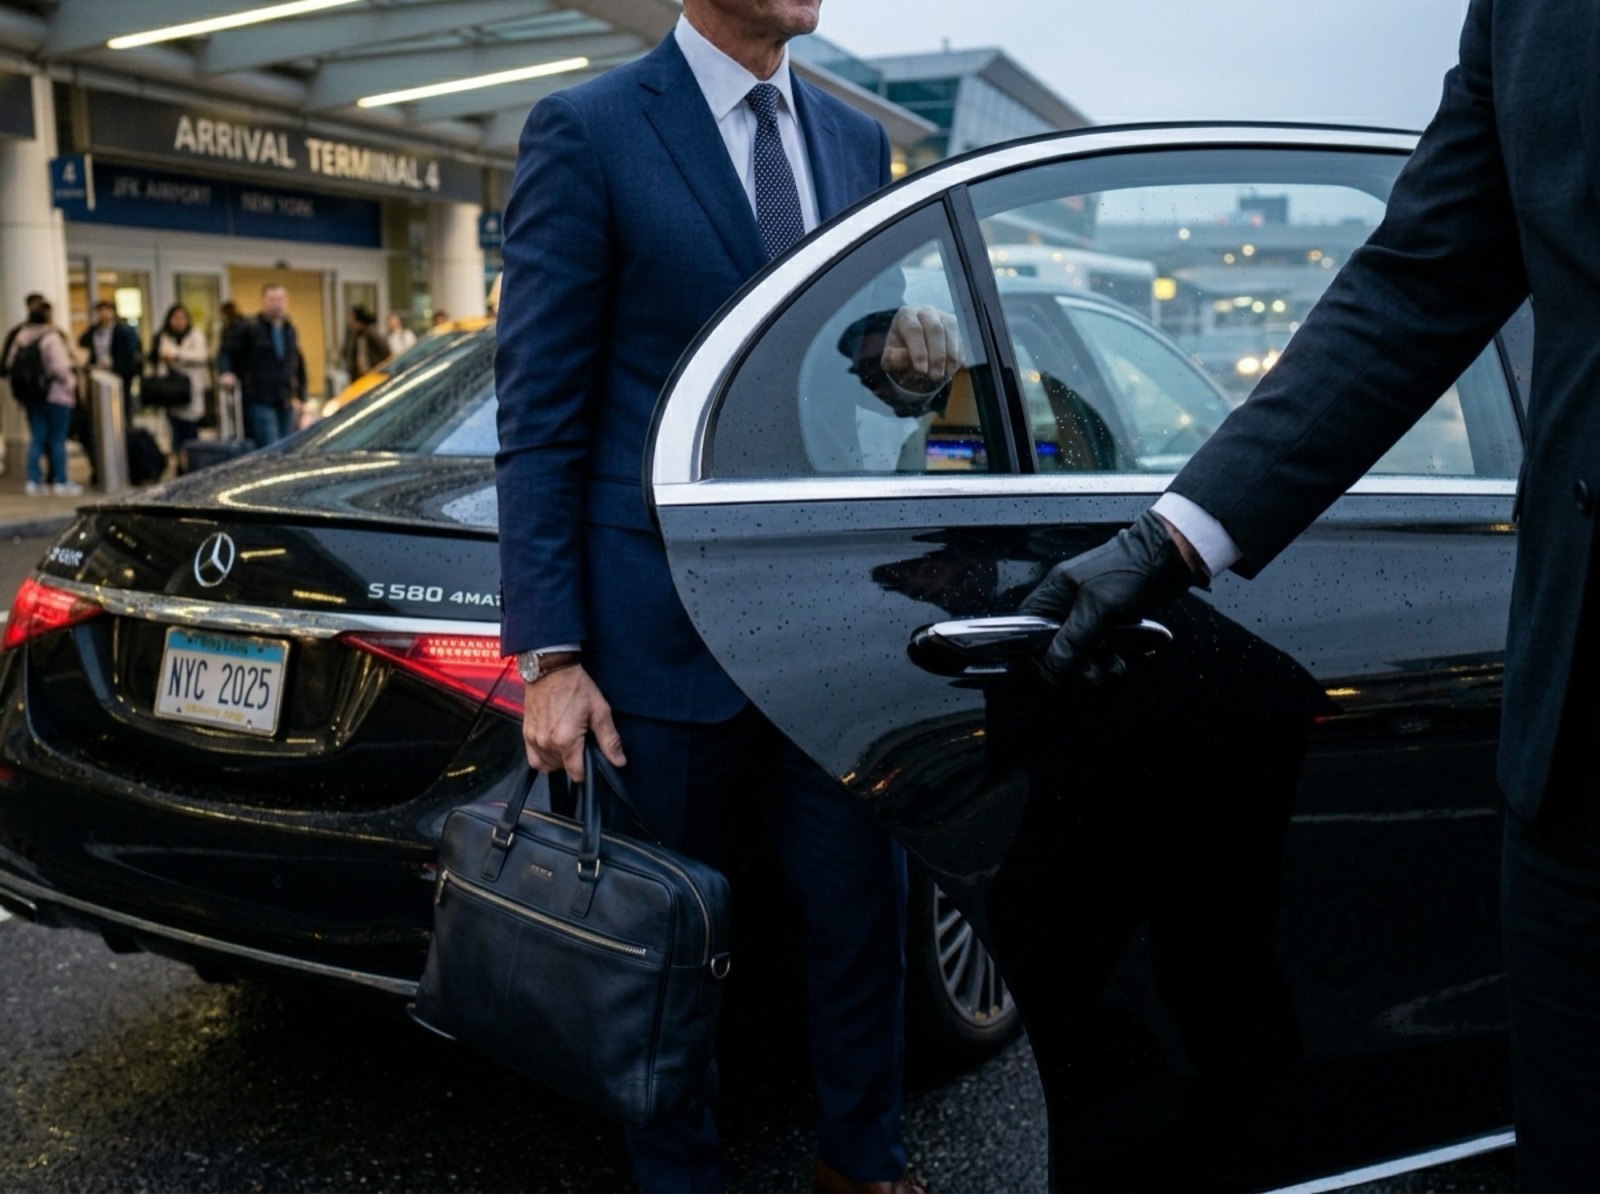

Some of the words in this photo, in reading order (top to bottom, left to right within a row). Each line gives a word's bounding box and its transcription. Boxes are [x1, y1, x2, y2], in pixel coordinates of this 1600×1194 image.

[62, 161, 77, 184] 4
[174, 115, 297, 169] ARRIVAL
[305, 138, 423, 190] TERMINAL
[425, 160, 440, 192] 4
[368, 583, 385, 599] S
[388, 584, 444, 602] 580
[167, 656, 208, 700] NYC
[218, 663, 272, 710] 2025
